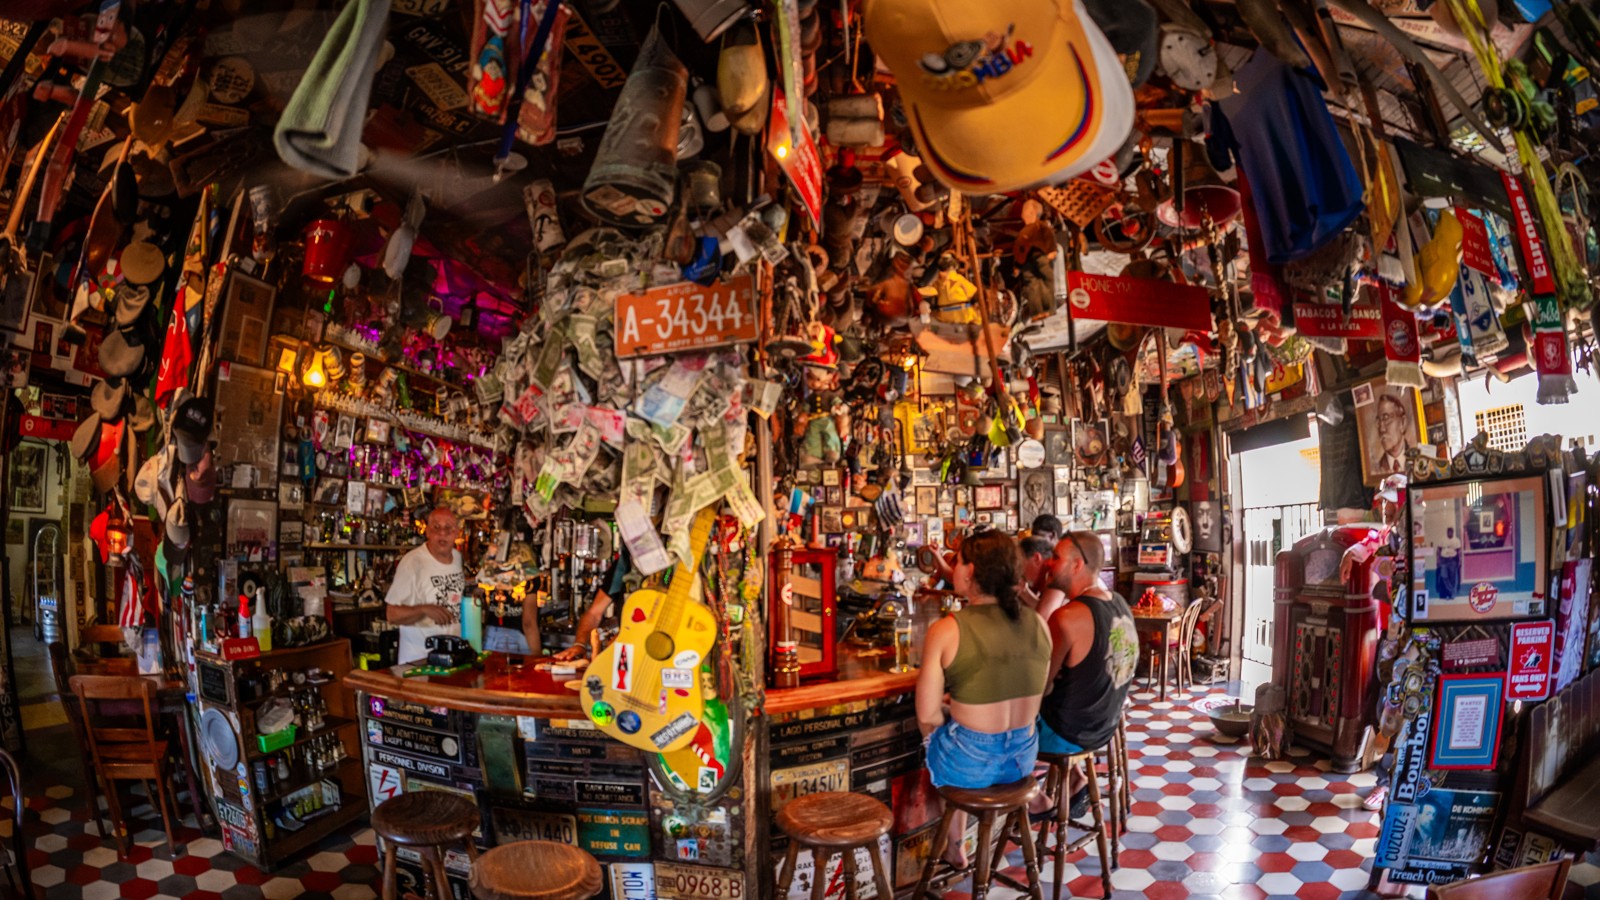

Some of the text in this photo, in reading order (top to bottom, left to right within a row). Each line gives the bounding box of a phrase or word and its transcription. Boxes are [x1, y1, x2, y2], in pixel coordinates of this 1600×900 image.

[622, 290, 743, 344] A-34344
[1296, 308, 1381, 320] TABACOS BANOS
[1516, 627, 1550, 637] RESERVED
[1517, 635, 1547, 645] PARKING
[1511, 673, 1547, 683] FANS ONLY
[780, 714, 865, 737] LAGO PERSONAL ONLY
[396, 727, 436, 742] ADMITTANCE
[378, 752, 446, 776] PERSONNEL DIVISION
[623, 842, 641, 851] CAN
